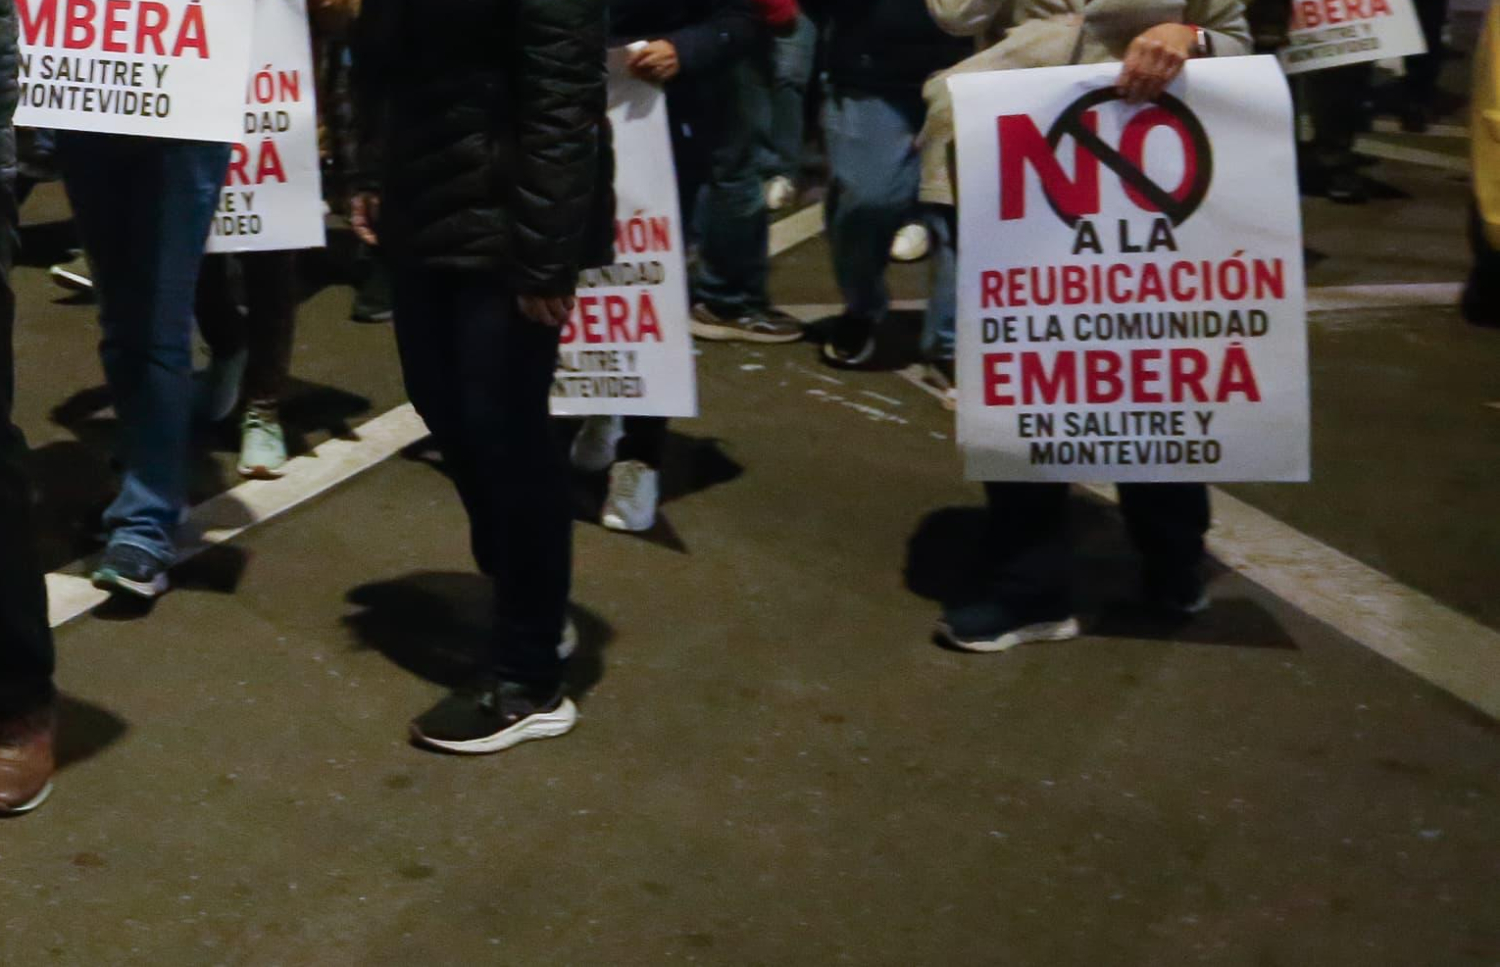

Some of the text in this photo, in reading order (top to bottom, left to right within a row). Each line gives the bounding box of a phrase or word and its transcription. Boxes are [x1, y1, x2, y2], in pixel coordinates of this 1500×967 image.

[40, 54, 144, 88] SALITRE
[152, 63, 169, 89] Y
[996, 105, 1197, 221] NO
[1072, 217, 1178, 255] A LA
[980, 249, 1285, 309] REUBICACIÓN
[981, 309, 1269, 344] DE LA COMUNIDAD
[1018, 410, 1214, 438] EN SALITRE Y
[1029, 439, 1222, 465] MONTEVIDEO
